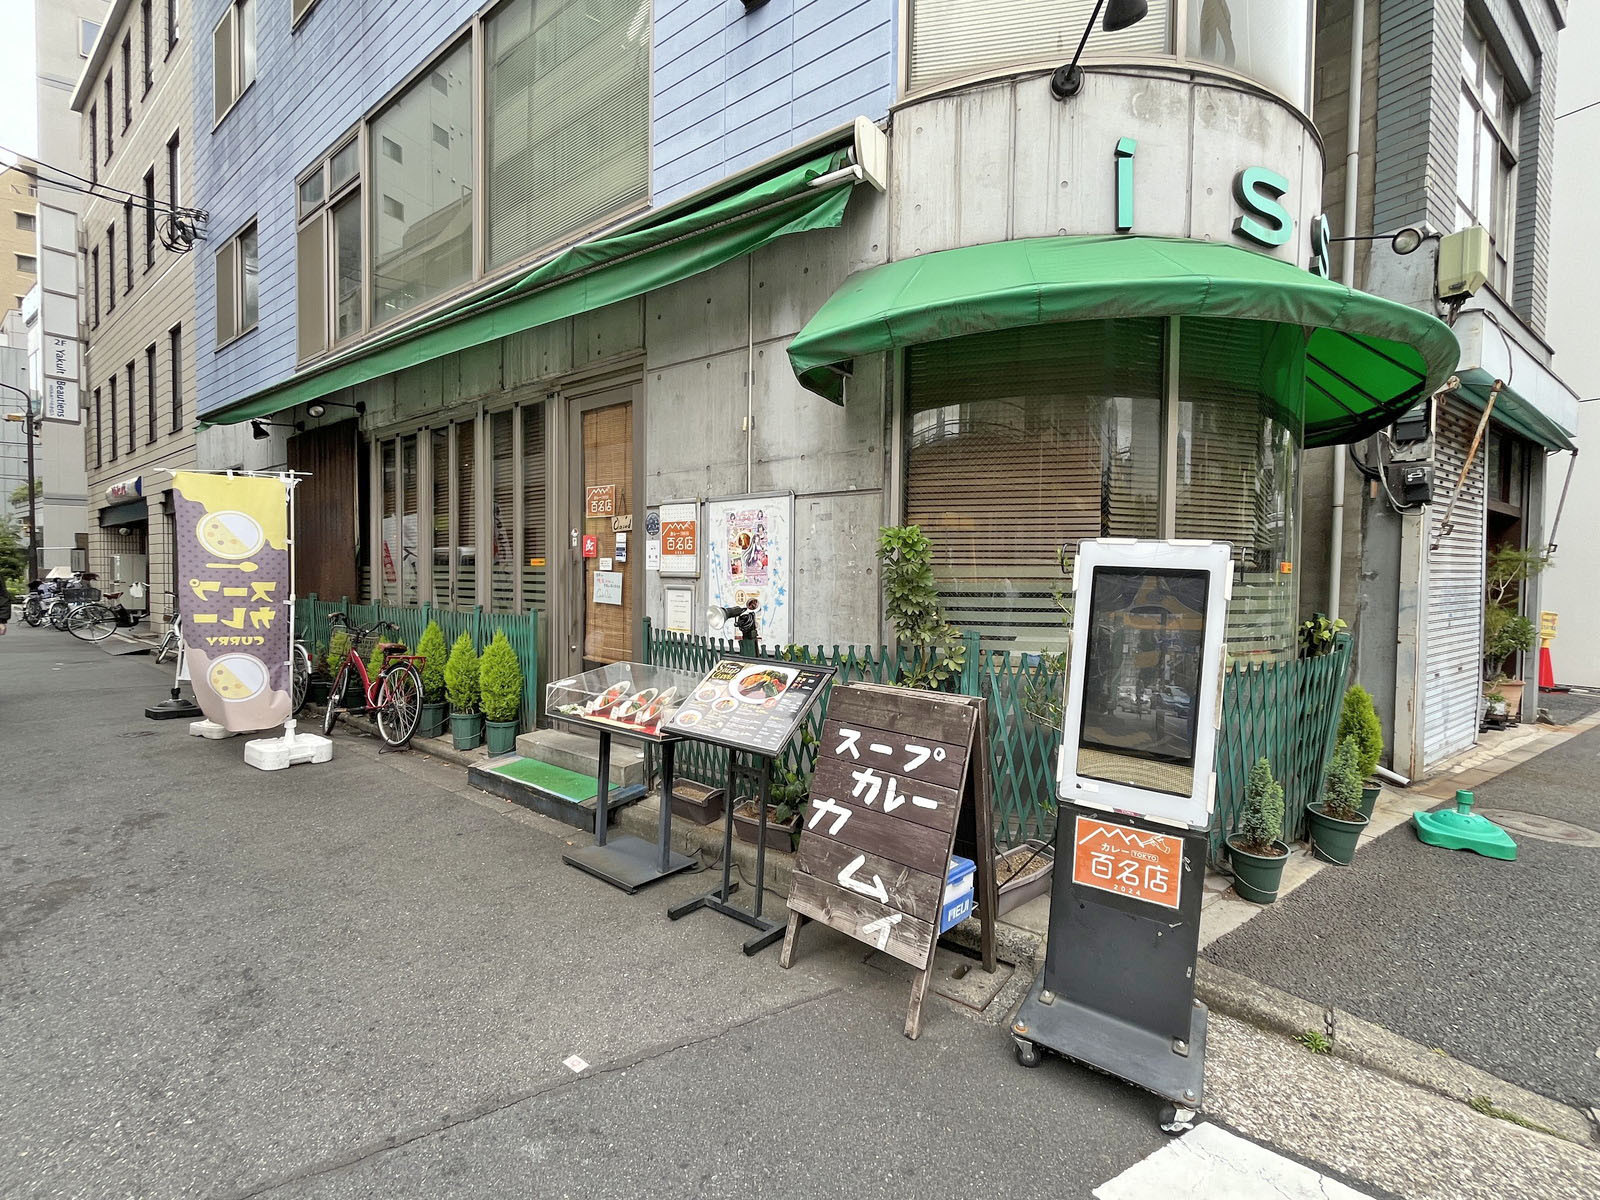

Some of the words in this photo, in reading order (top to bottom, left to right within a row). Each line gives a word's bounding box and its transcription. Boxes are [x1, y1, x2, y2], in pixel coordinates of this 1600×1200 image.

[54, 339, 67, 347] 2F
[55, 349, 67, 375] Yakult
[667, 536, 693, 550] 百名店
[835, 728, 946, 772] スープ
[851, 768, 938, 812] カレー
[1101, 842, 1130, 854] カレー
[1132, 850, 1158, 861] TOKYO
[1090, 851, 1169, 893] 百名店
[1113, 884, 1141, 896] 2024
